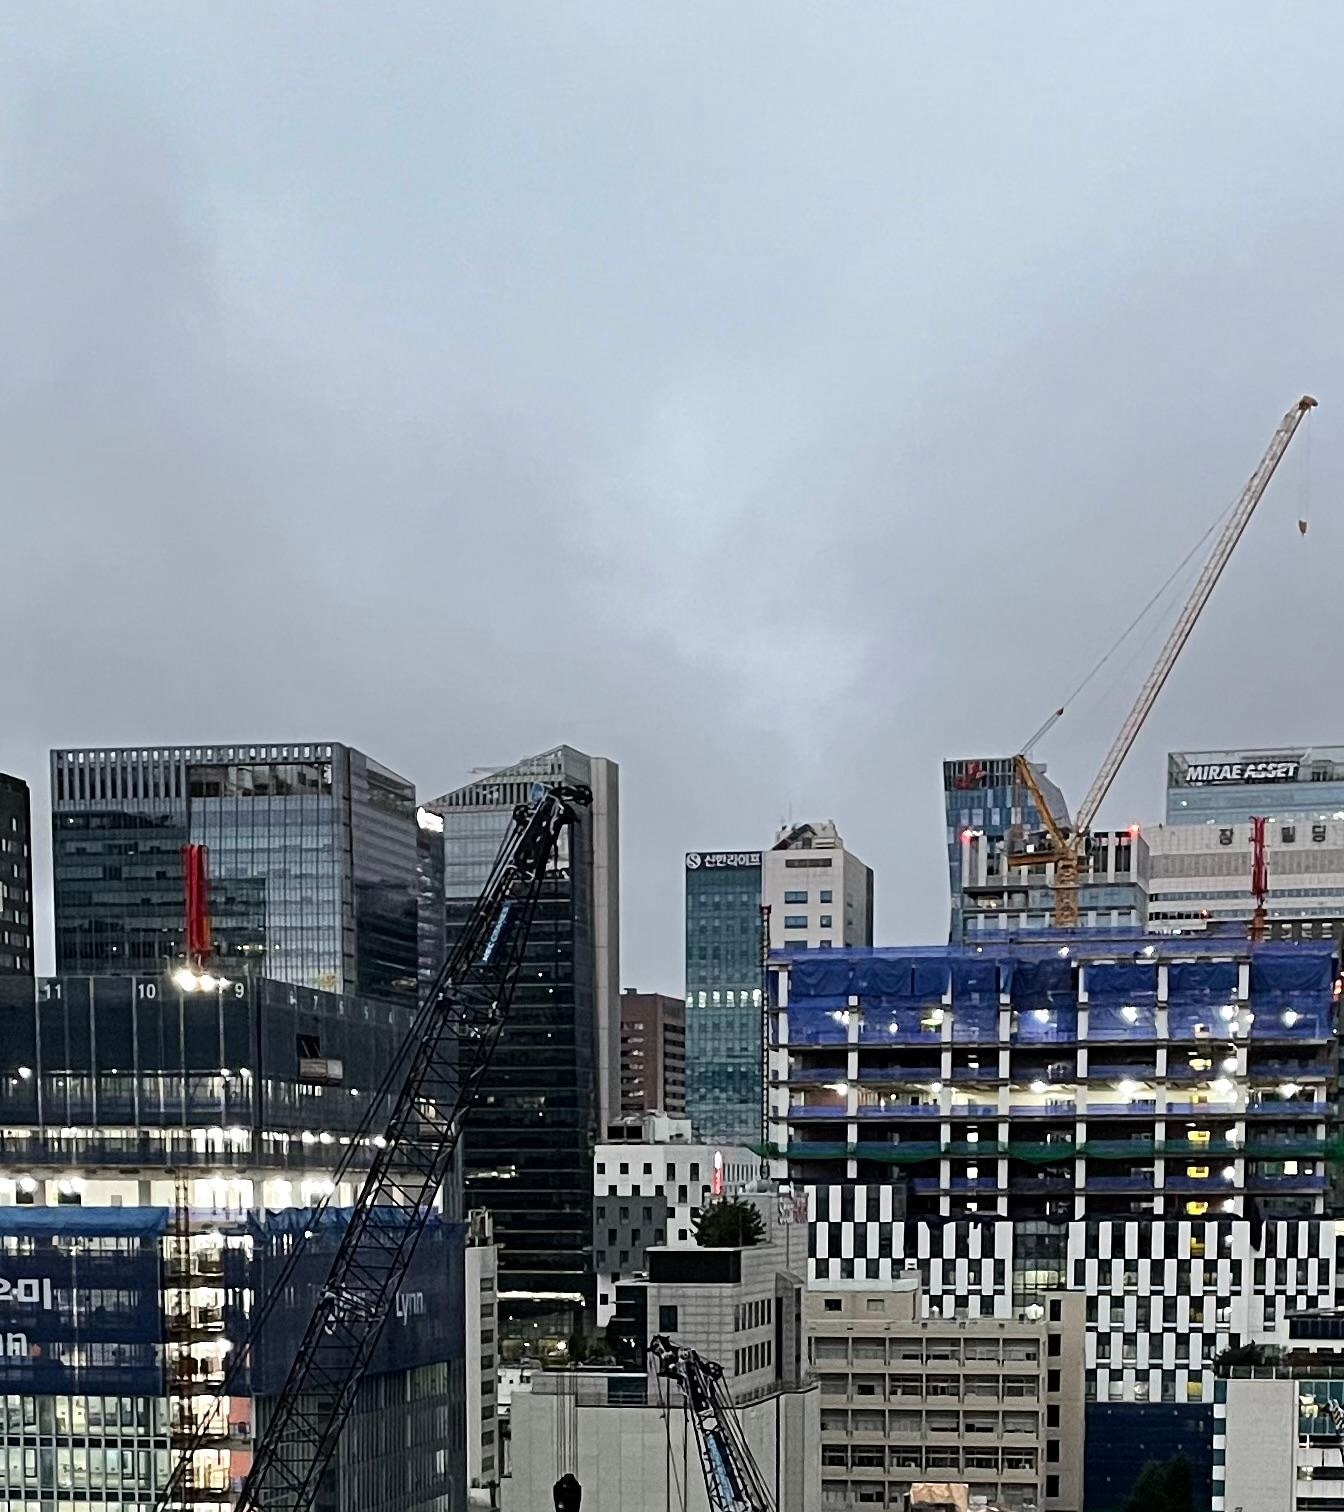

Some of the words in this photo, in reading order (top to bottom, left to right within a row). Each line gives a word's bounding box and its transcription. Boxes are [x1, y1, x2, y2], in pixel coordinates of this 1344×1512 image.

[1186, 764, 1242, 781] MIRAE
[1244, 761, 1298, 779] ASSET
[1218, 825, 1327, 846] 장빌딩
[704, 853, 761, 868] 신한라이프
[45, 984, 61, 1000] 11
[138, 983, 156, 999] 10
[235, 982, 244, 998] 9
